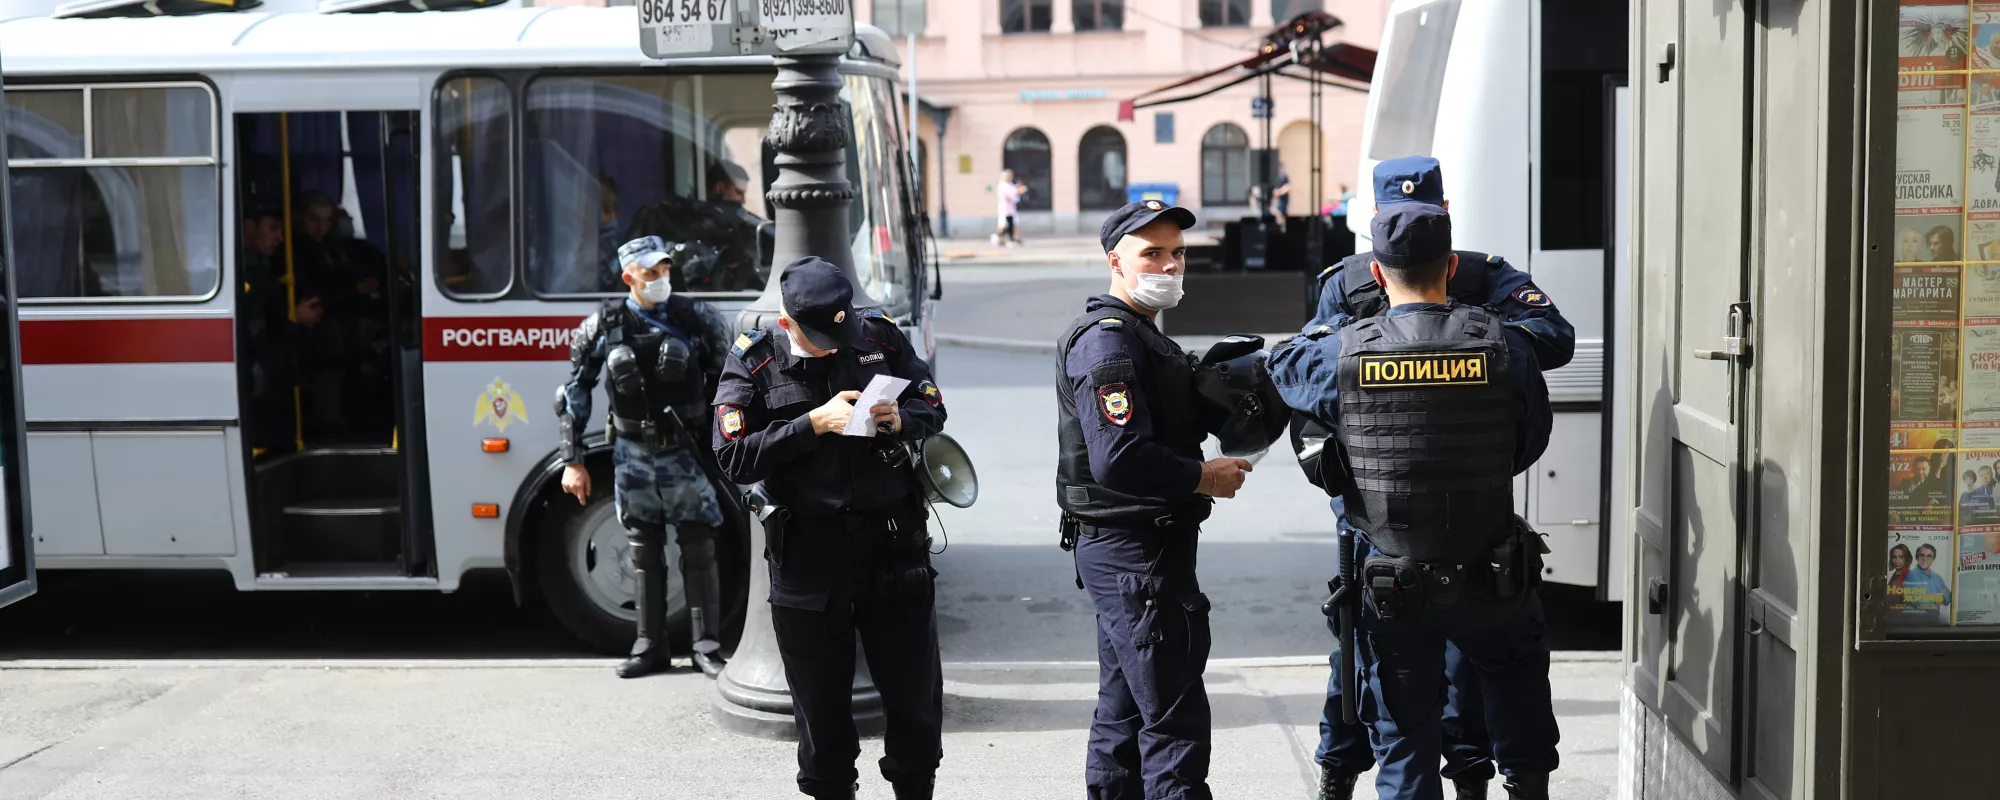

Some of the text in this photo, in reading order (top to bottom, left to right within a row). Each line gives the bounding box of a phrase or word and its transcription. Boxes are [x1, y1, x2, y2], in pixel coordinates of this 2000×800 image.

[643, 0, 727, 23] 964 54 67
[1896, 173, 1930, 184] УССКАЯ
[1972, 199, 2000, 209] ДОВЛ
[1902, 277, 1943, 288] МАСТЕР
[1893, 287, 1952, 299] МАРГАРИТА
[1365, 358, 1482, 381] ПОЛИЦИЯ
